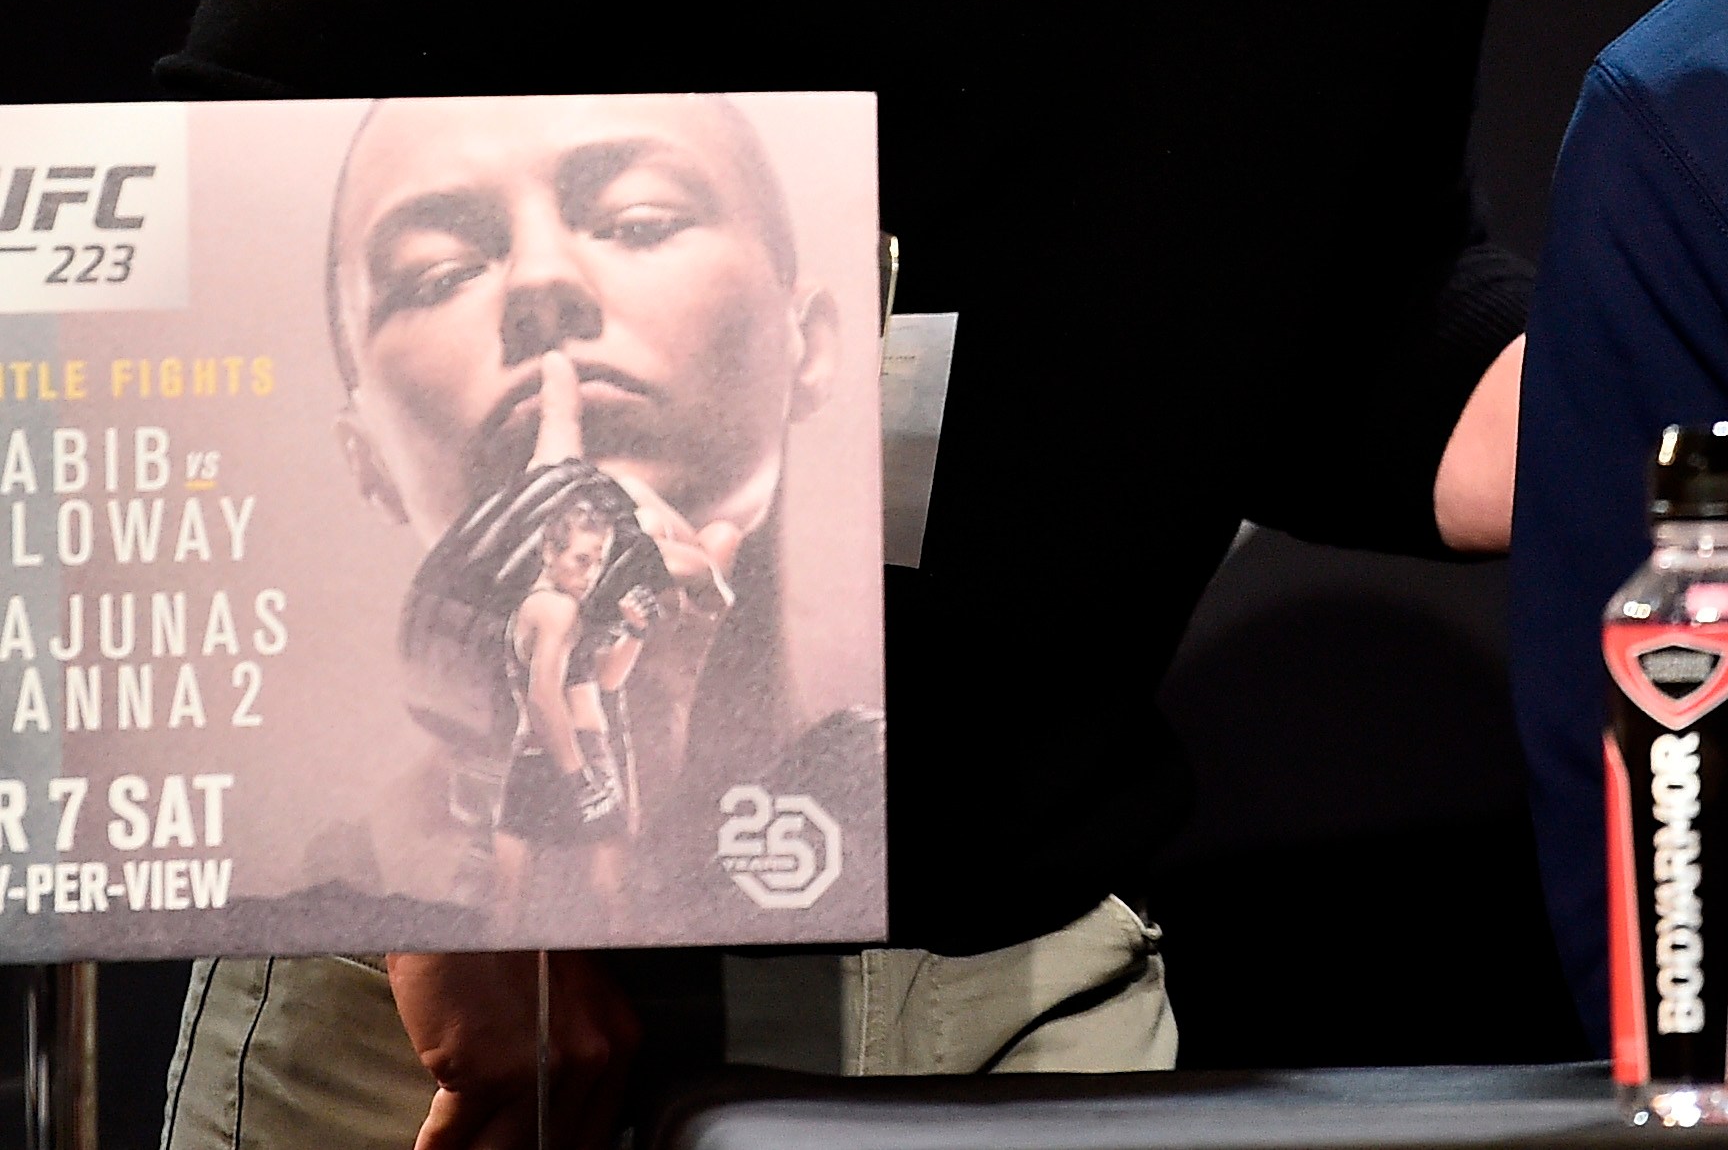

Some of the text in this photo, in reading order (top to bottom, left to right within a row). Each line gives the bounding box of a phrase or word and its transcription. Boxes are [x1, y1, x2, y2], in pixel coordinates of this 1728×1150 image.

[45, 245, 135, 284] 223
[110, 355, 275, 400] FIGHTS
[0, 426, 171, 495] ABIB
[11, 497, 256, 567] LOWAY
[0, 588, 289, 661] AJUNAS
[12, 661, 264, 733] ANNA 2
[48, 777, 89, 851] 7
[107, 773, 235, 851] SAT
[0, 858, 233, 914] -PER-VIEW
[1650, 730, 1706, 1035] BODYARMOR
